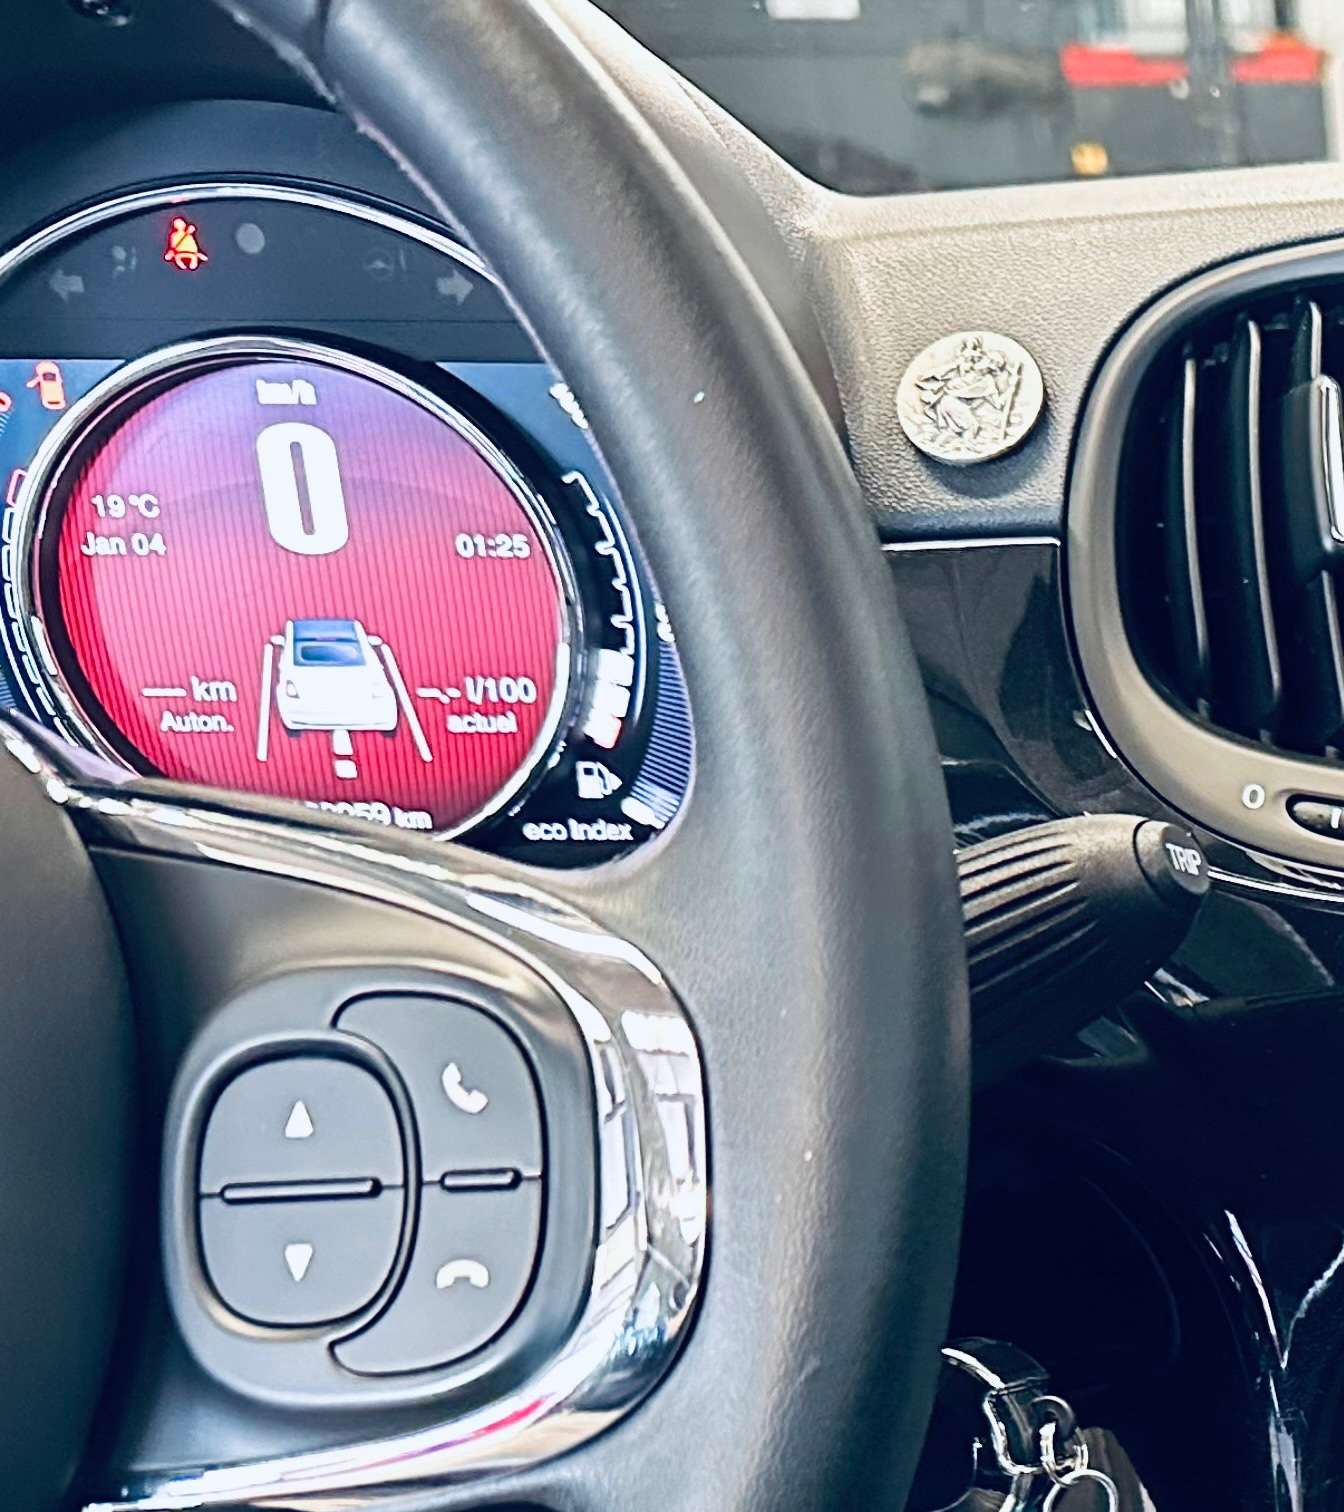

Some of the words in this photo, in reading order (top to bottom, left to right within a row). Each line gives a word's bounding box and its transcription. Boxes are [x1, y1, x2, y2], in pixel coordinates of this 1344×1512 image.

[255, 421, 349, 556] 0
[91, 494, 126, 518] 19
[81, 531, 127, 556] Jan
[131, 532, 167, 556] 04
[454, 532, 531, 559] 01:25
[191, 674, 238, 703] km
[160, 710, 235, 733] Auton.
[522, 819, 568, 841] eco
[1165, 842, 1202, 876] TRIP
